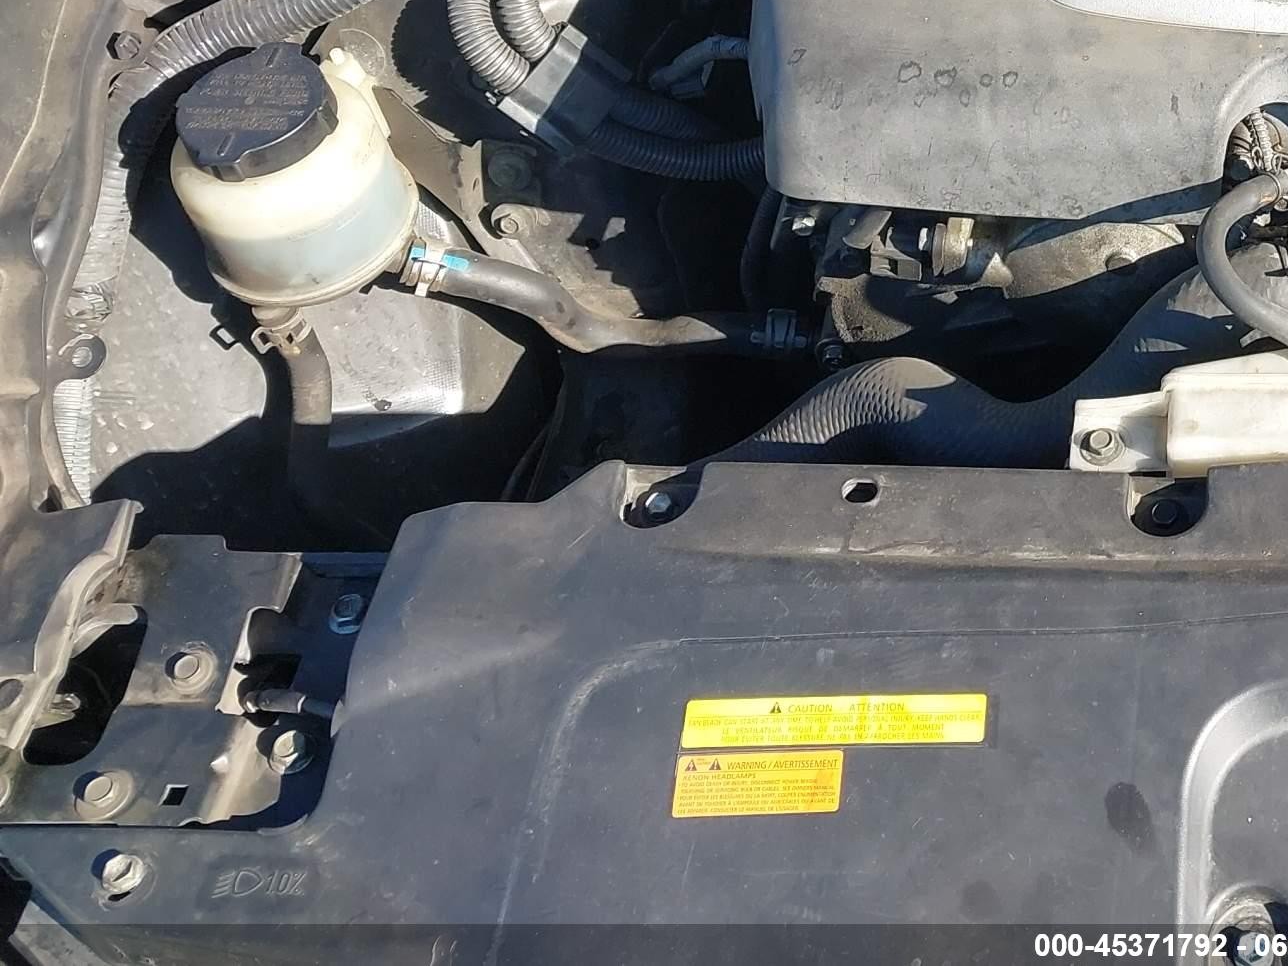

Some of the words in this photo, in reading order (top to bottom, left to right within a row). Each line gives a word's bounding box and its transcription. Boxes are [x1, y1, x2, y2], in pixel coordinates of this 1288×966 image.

[788, 704, 833, 713] CAUTION
[850, 702, 905, 713] ATTENTION
[727, 760, 768, 770] WARNING
[773, 759, 838, 769] AVERTISSEMENT
